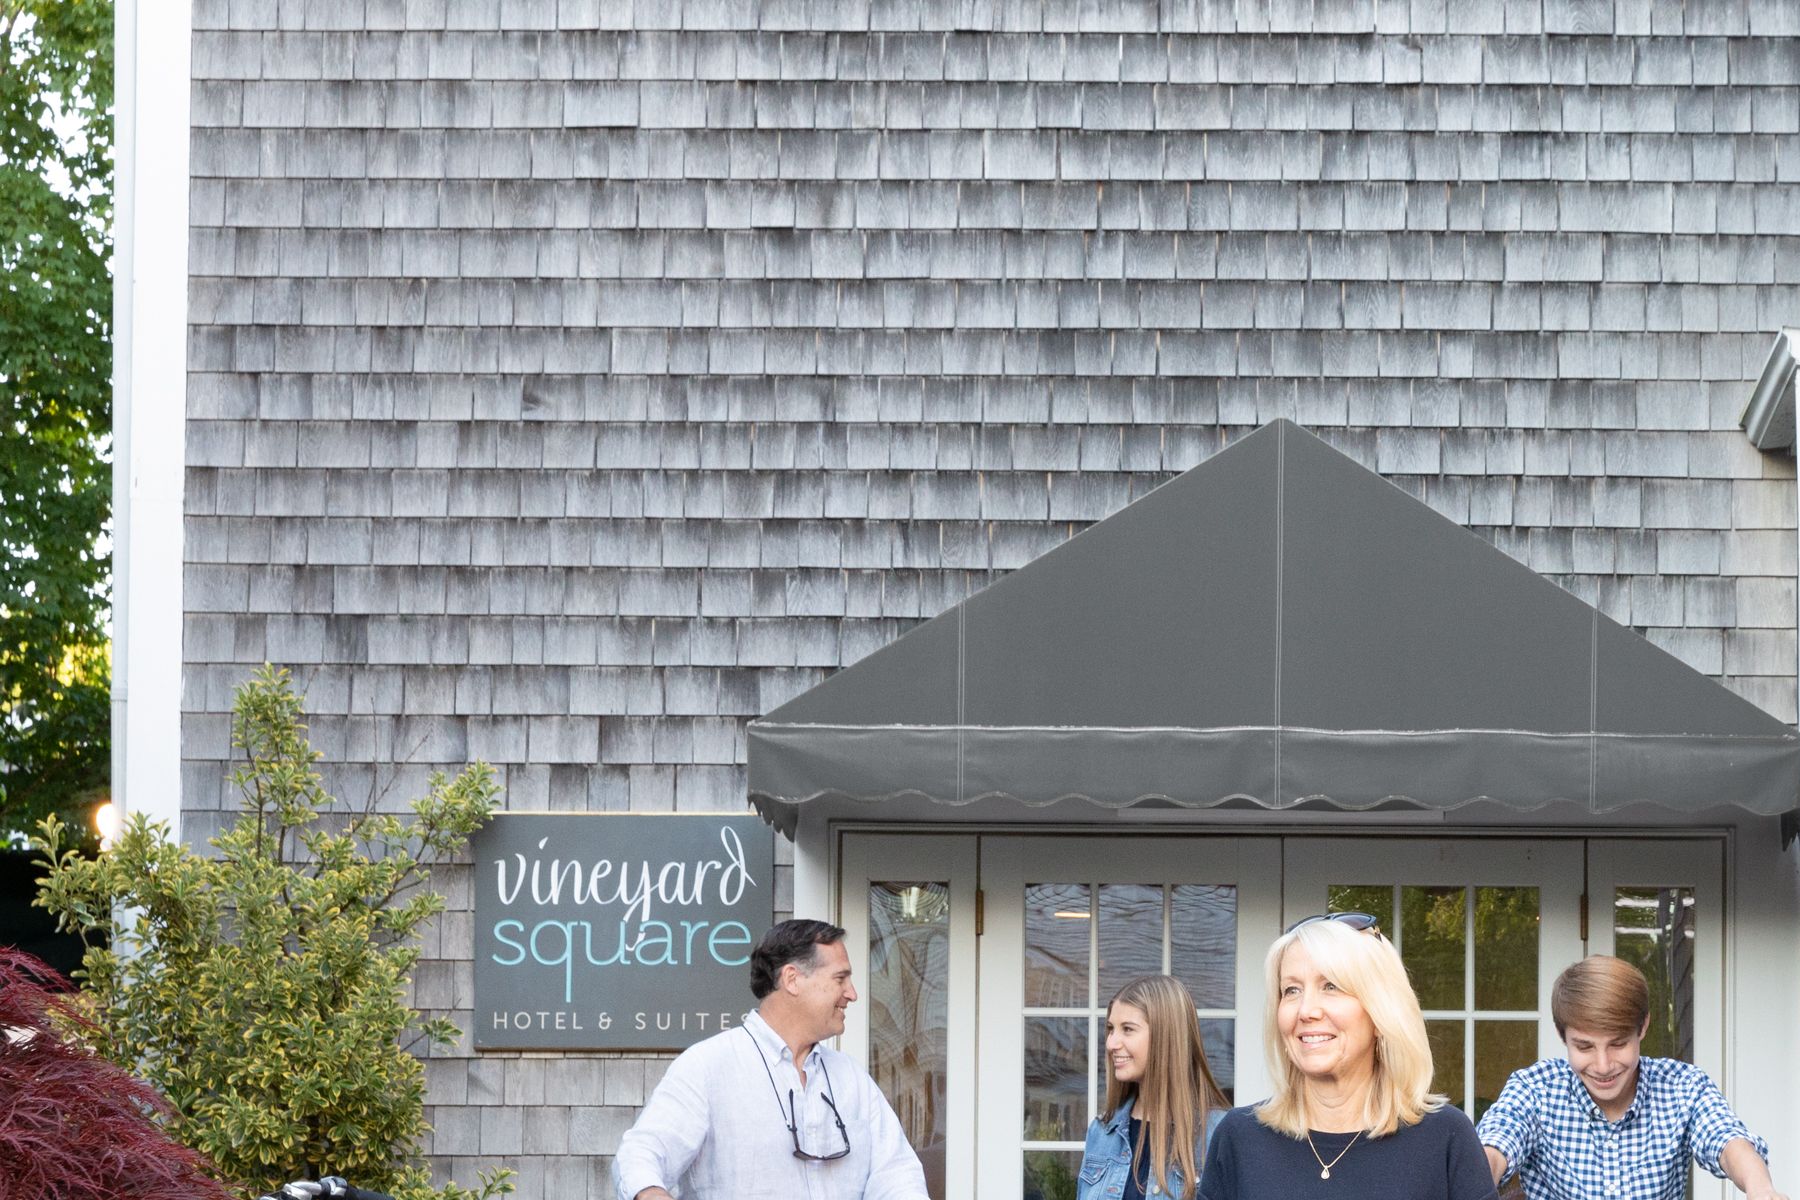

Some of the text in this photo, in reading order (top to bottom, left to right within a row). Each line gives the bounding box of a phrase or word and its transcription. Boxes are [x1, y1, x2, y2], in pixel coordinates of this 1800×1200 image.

[494, 825, 758, 952] vineyard
[491, 917, 752, 1003] square
[493, 1011, 584, 1030] HOTEL
[598, 1011, 614, 1030] &
